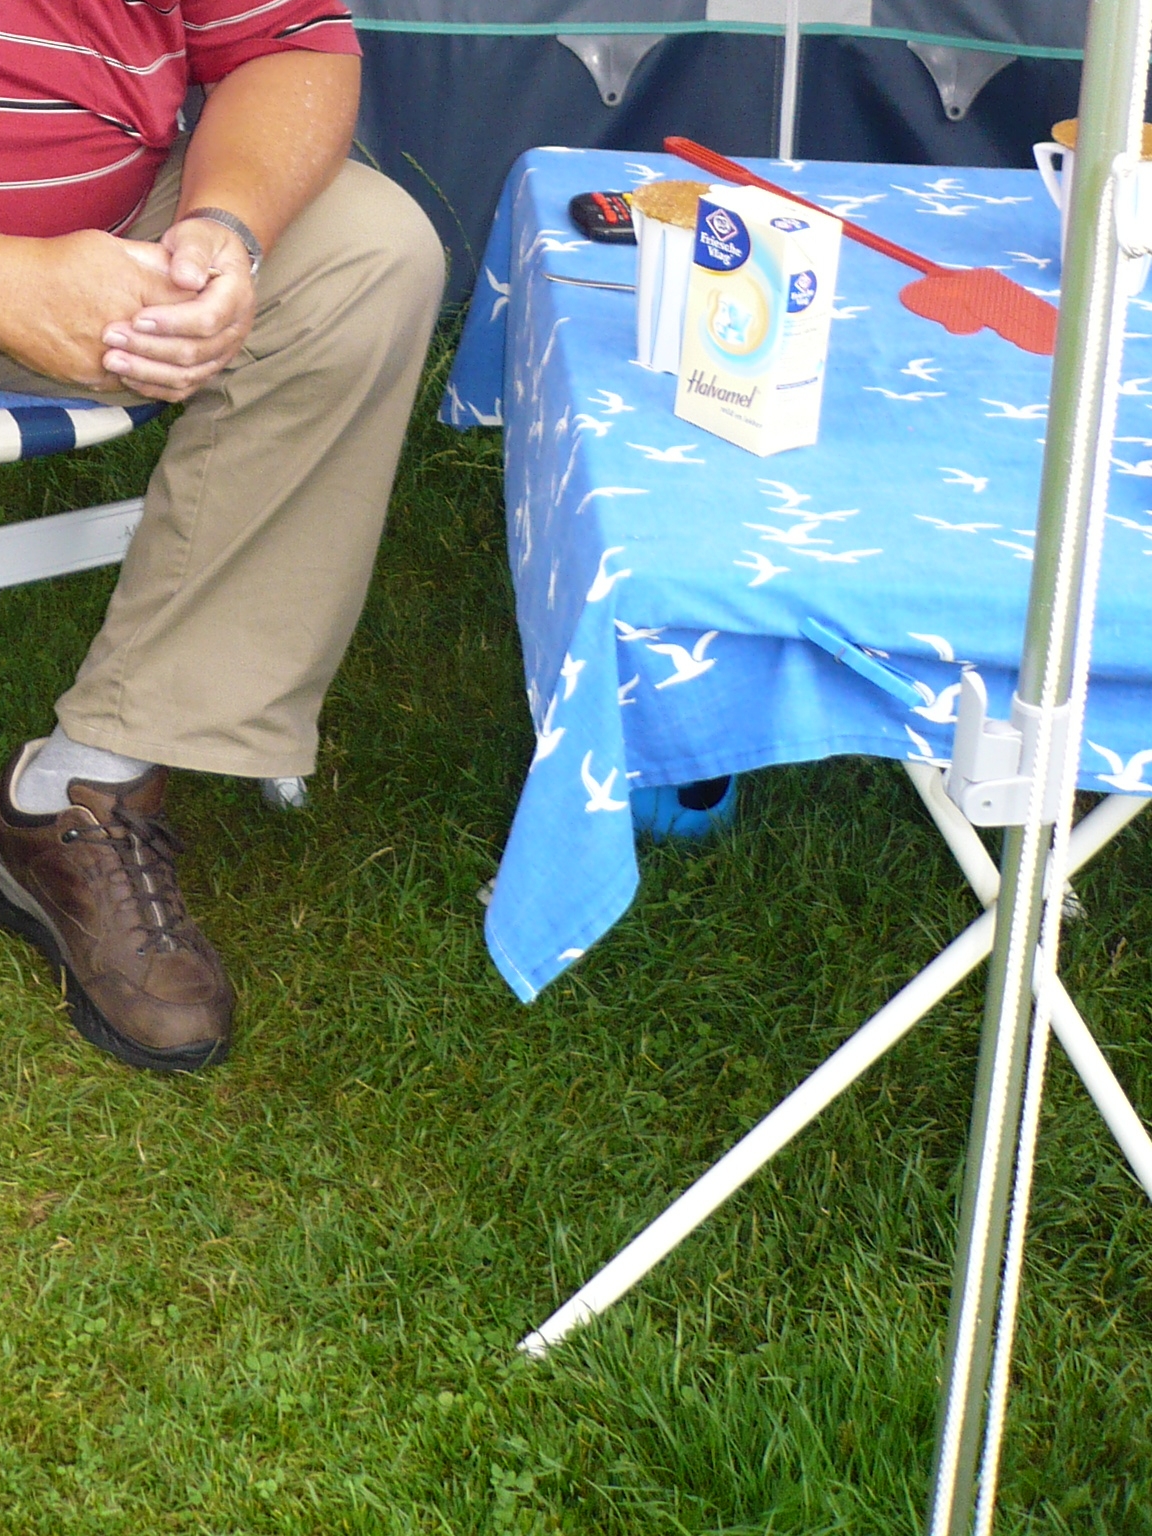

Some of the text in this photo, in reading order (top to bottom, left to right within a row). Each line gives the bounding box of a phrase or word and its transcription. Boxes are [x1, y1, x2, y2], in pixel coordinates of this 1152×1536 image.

[700, 231, 742, 257] Friesche
[708, 245, 731, 266] Vlag
[686, 369, 757, 408] Halvamel
